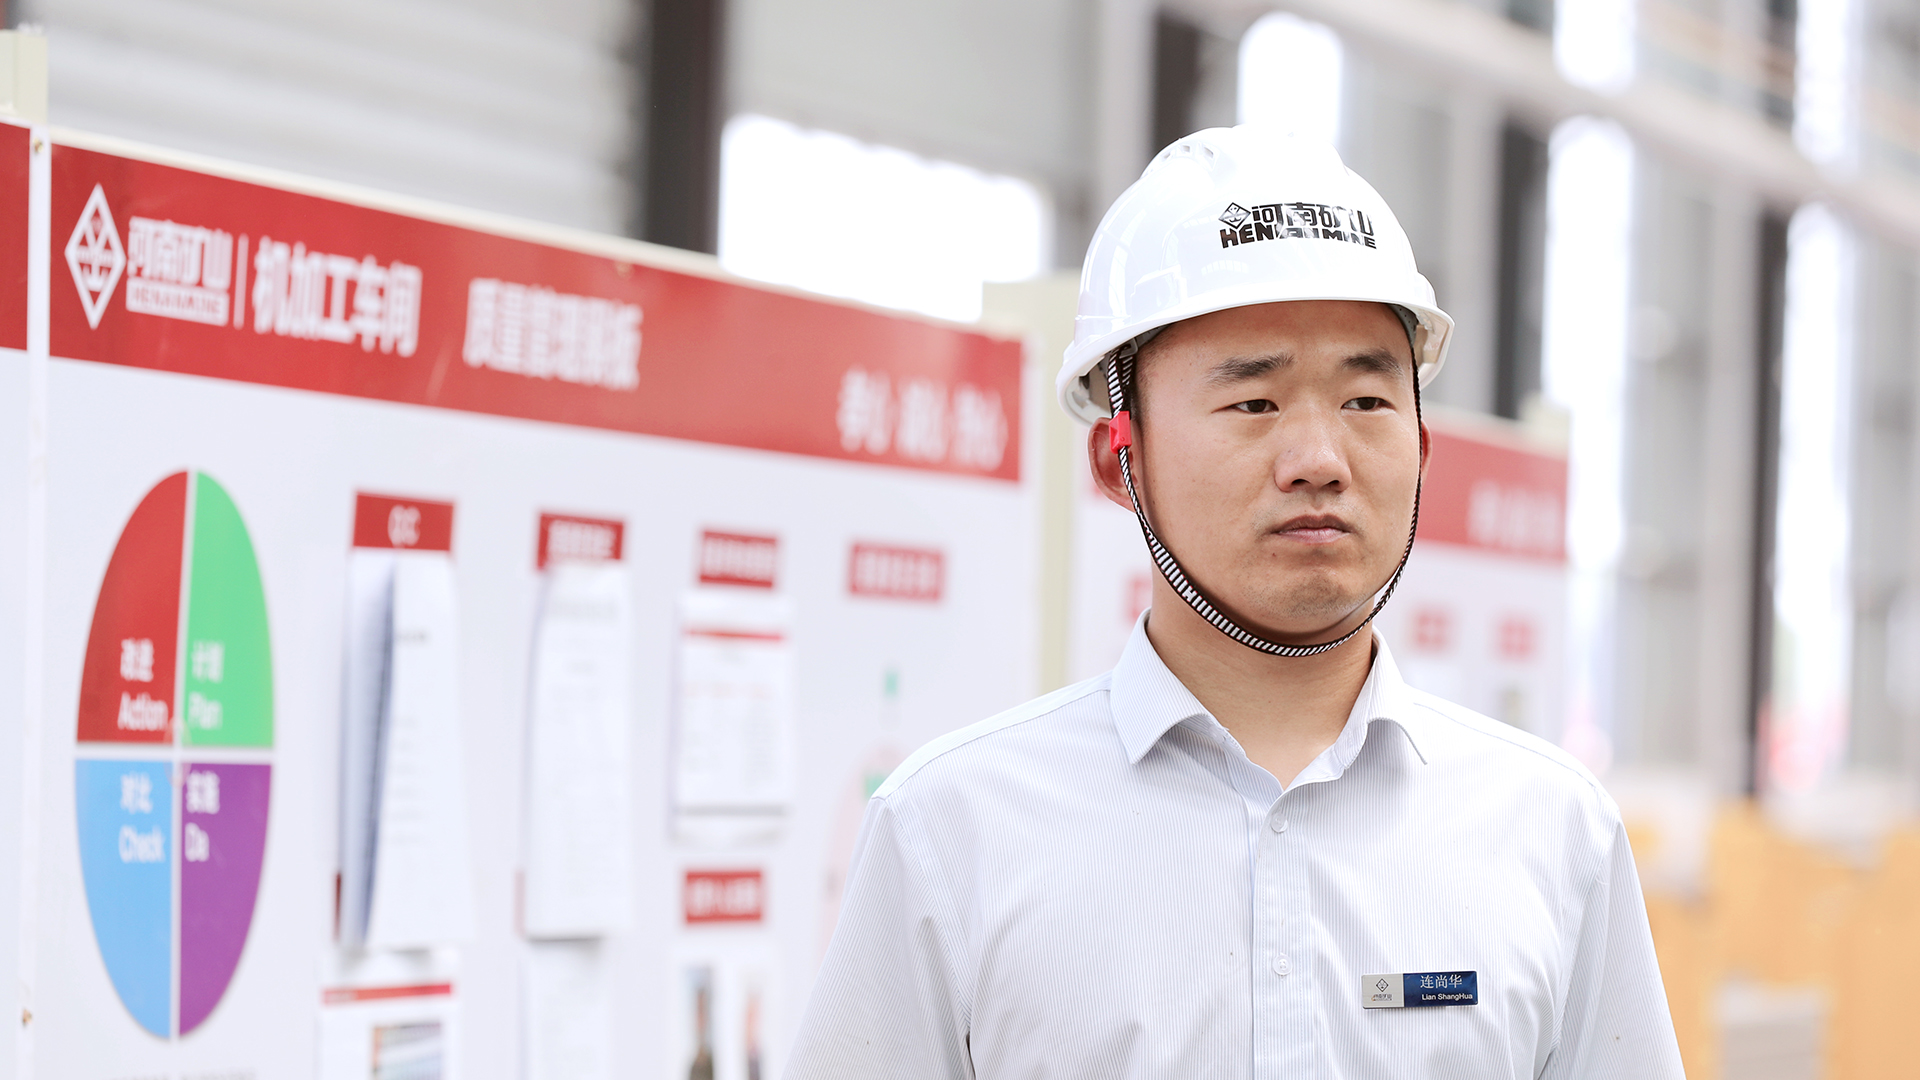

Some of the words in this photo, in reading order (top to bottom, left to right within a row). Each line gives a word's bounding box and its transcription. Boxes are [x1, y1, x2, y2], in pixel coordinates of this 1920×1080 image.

[117, 691, 169, 732] Action
[119, 824, 165, 863] Check
[1420, 974, 1462, 989] 连尚华
[1421, 993, 1437, 1001] Lian
[1438, 992, 1473, 1002] ShangHua
